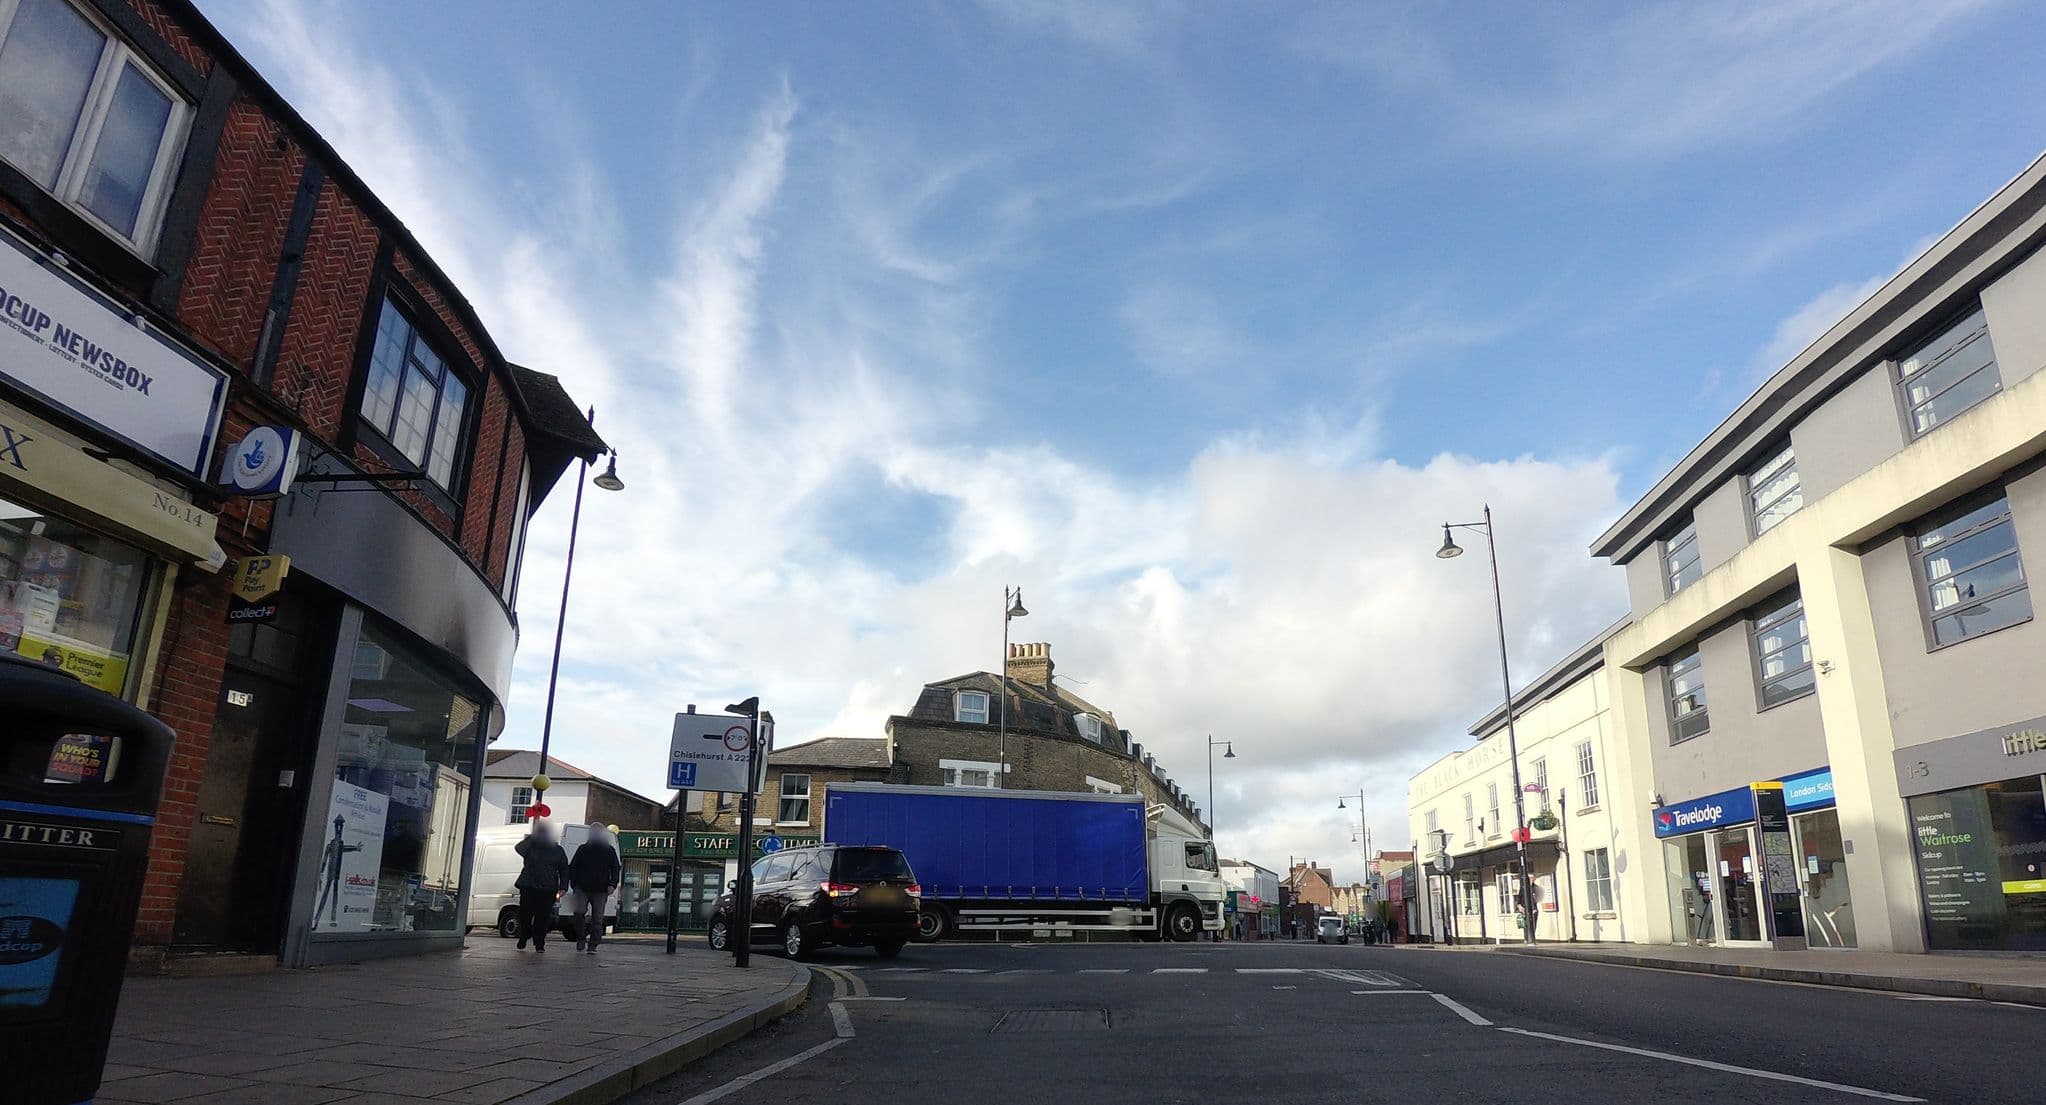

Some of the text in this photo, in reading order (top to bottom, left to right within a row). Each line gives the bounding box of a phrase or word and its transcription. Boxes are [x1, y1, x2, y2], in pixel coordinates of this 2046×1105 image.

[53, 322, 153, 397] NEWSBOX
[0, 424, 34, 472] X
[152, 492, 203, 528] No.14
[68, 651, 105, 669] Premier
[66, 661, 104, 679] League
[61, 743, 99, 758] WHO'S
[2002, 729, 2046, 757] little
[53, 752, 101, 768] IN YOUR
[673, 750, 724, 761] Chislehurst
[677, 764, 690, 779] H
[1906, 761, 1929, 779] 1-3
[1790, 786, 1816, 798] London
[1673, 804, 1723, 828] Travelodge
[1916, 812, 1952, 822] Welcome to
[1918, 826, 1937, 836] little
[638, 836, 677, 848] BETTE
[694, 838, 734, 849] STAFF
[1920, 833, 1971, 847] Waitrose
[1922, 851, 1942, 860] Sidcup
